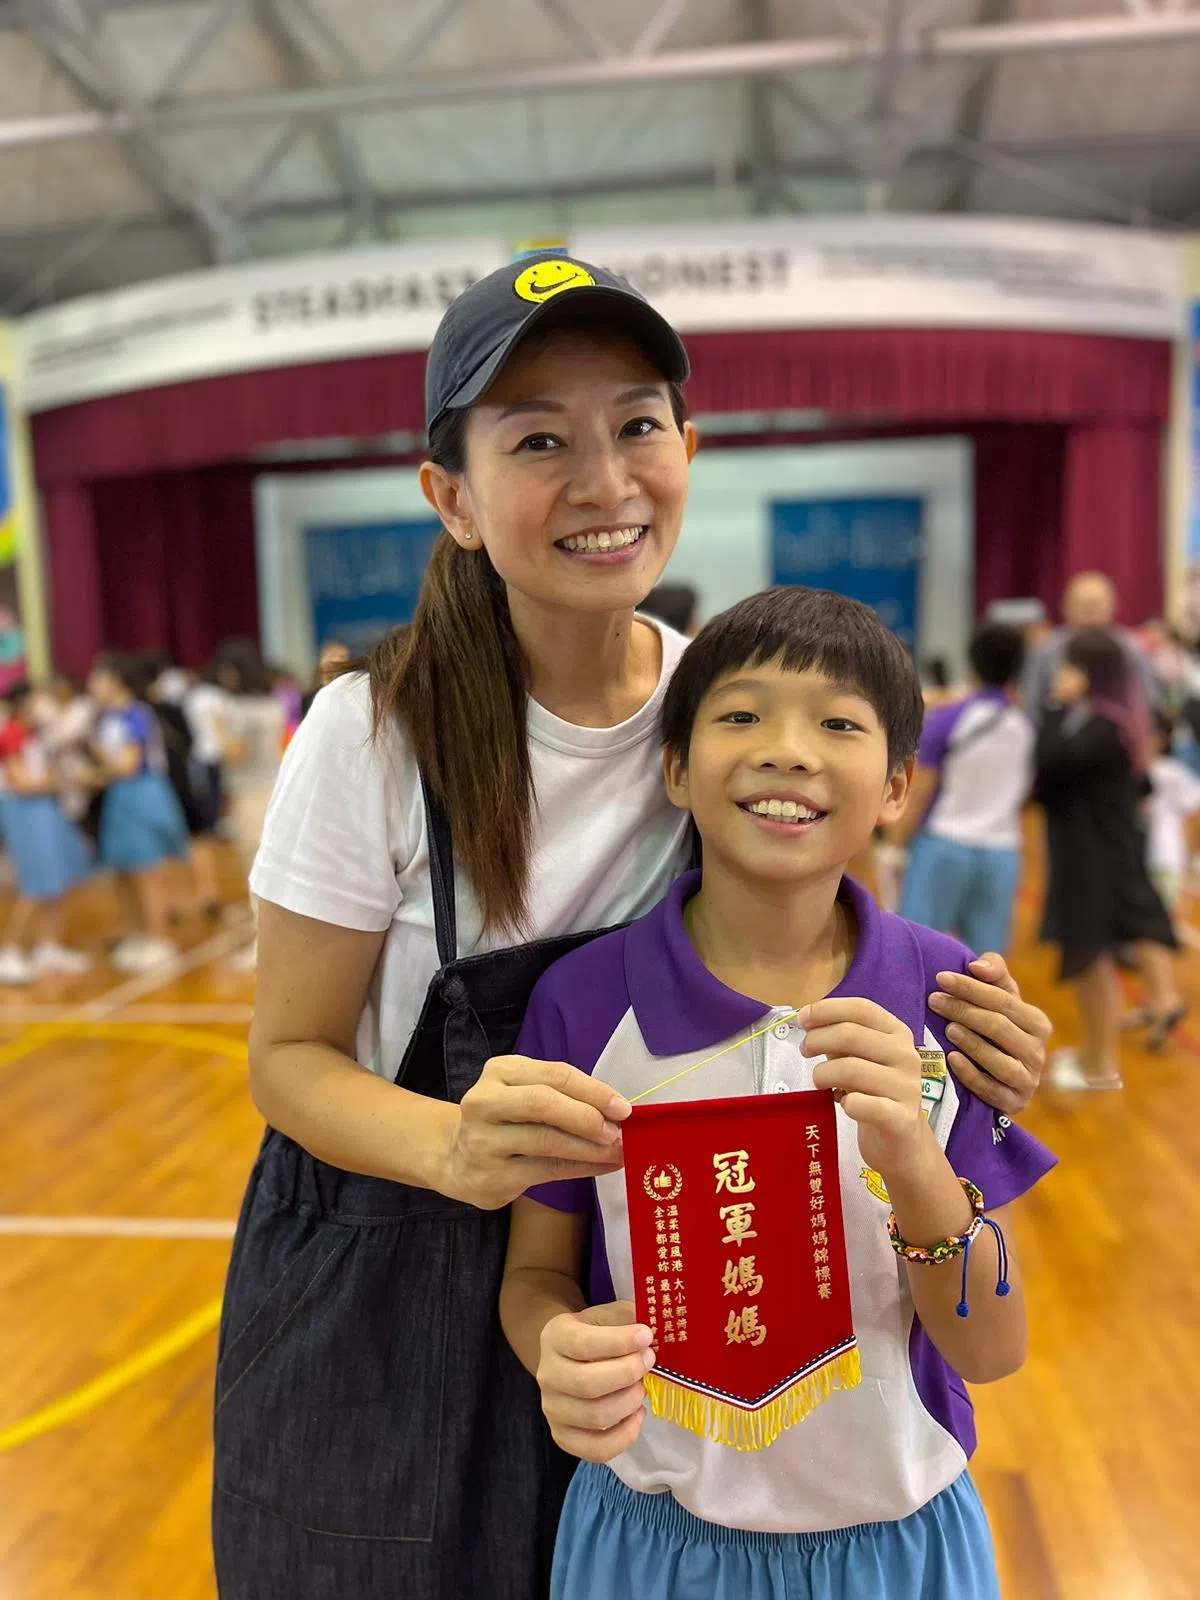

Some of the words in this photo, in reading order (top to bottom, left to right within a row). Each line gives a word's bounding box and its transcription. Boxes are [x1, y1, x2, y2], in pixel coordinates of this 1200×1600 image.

[712, 1149, 768, 1347] 冠軍媽媽
[804, 1124, 833, 1300] 天下無雙好媽媽錦標賽
